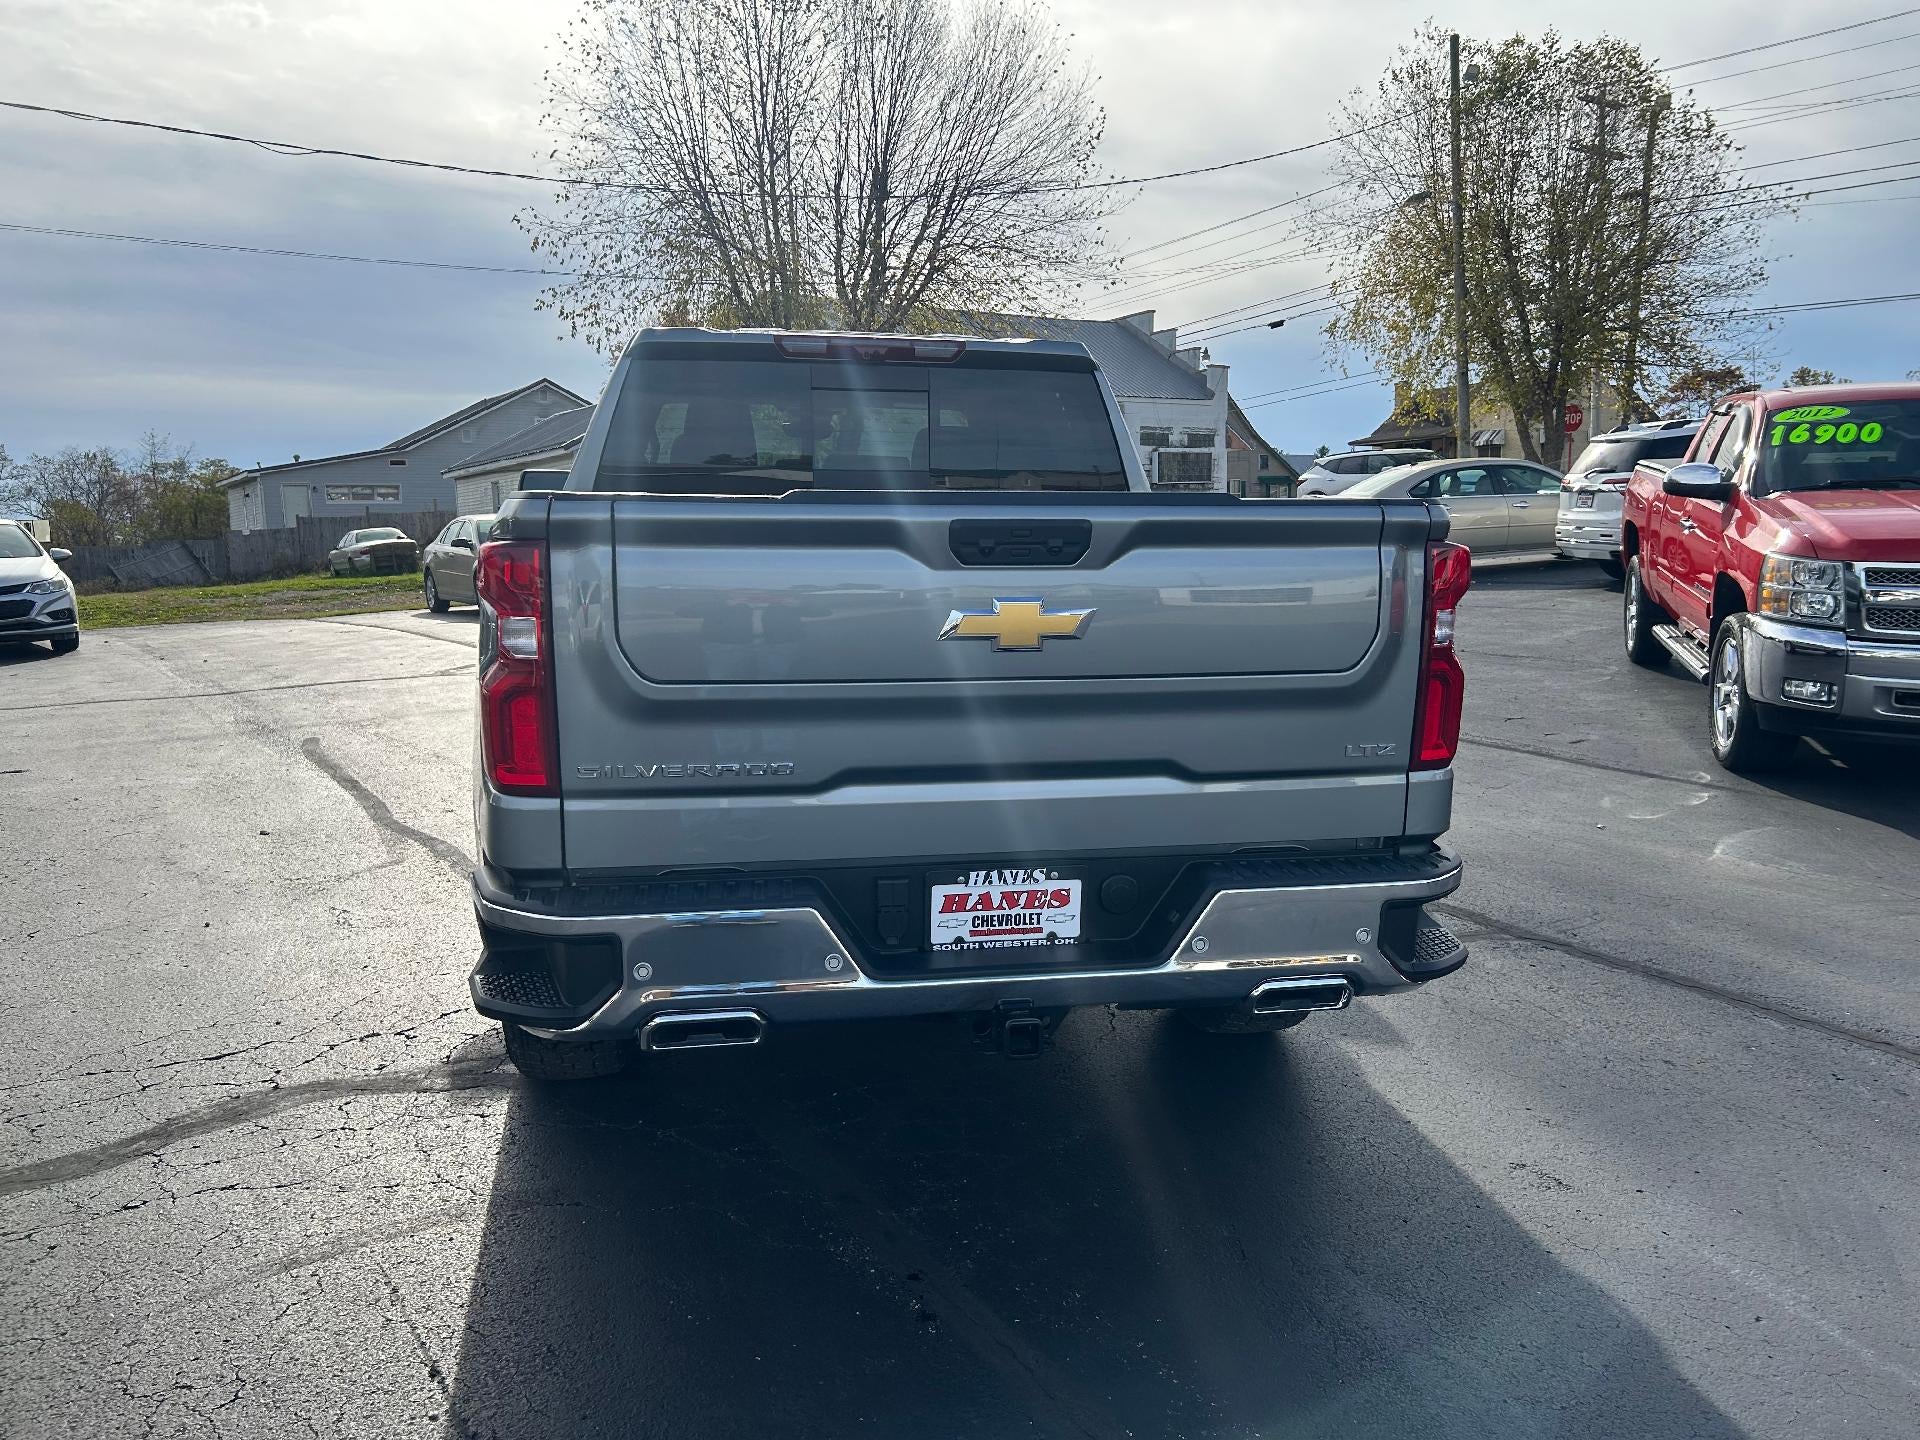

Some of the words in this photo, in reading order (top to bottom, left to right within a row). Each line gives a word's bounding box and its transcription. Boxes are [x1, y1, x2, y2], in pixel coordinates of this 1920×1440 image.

[1786, 408, 1837, 420] 2012
[1770, 422, 1883, 446] 16900
[1344, 744, 1396, 758] LTZ
[576, 762, 796, 779] SILVERADO
[967, 868, 1047, 887] HANES
[939, 888, 1071, 914] HANES
[971, 912, 1043, 928] CHEVROLET
[932, 943, 979, 951] SOUTH
